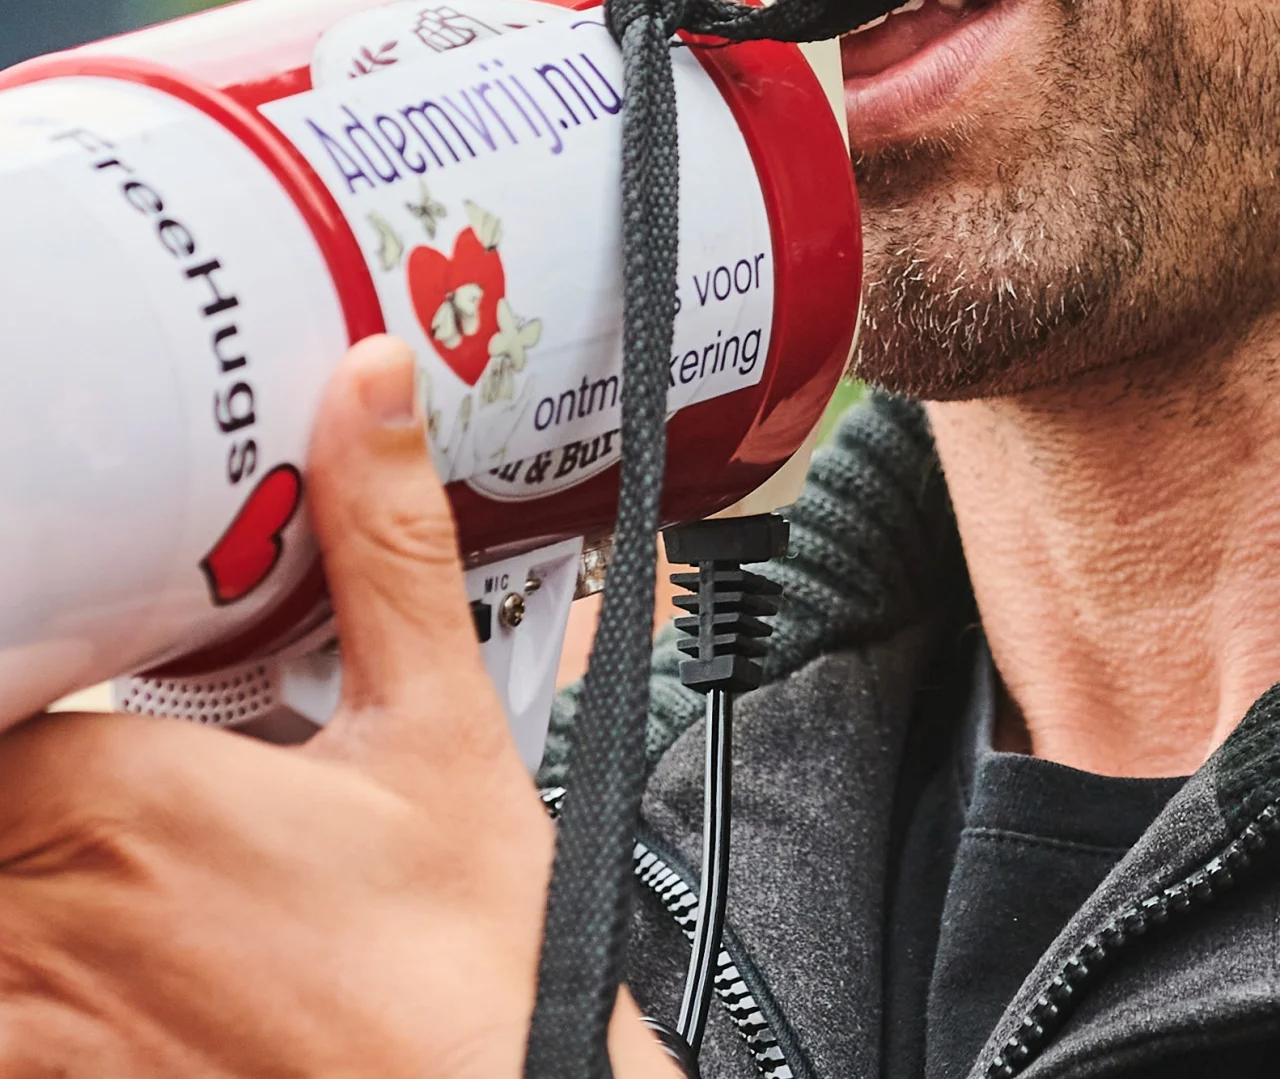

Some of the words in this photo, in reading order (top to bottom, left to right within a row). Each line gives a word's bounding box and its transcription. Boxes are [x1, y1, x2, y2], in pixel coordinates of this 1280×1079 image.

[304, 52, 621, 194] Ademvrij.nu
[49, 127, 258, 486] FreeHugs
[692, 252, 765, 307] voor
[533, 328, 762, 432] ontmkering
[524, 450, 553, 485] &
[552, 428, 622, 480] Bur
[484, 573, 509, 594] MIC
